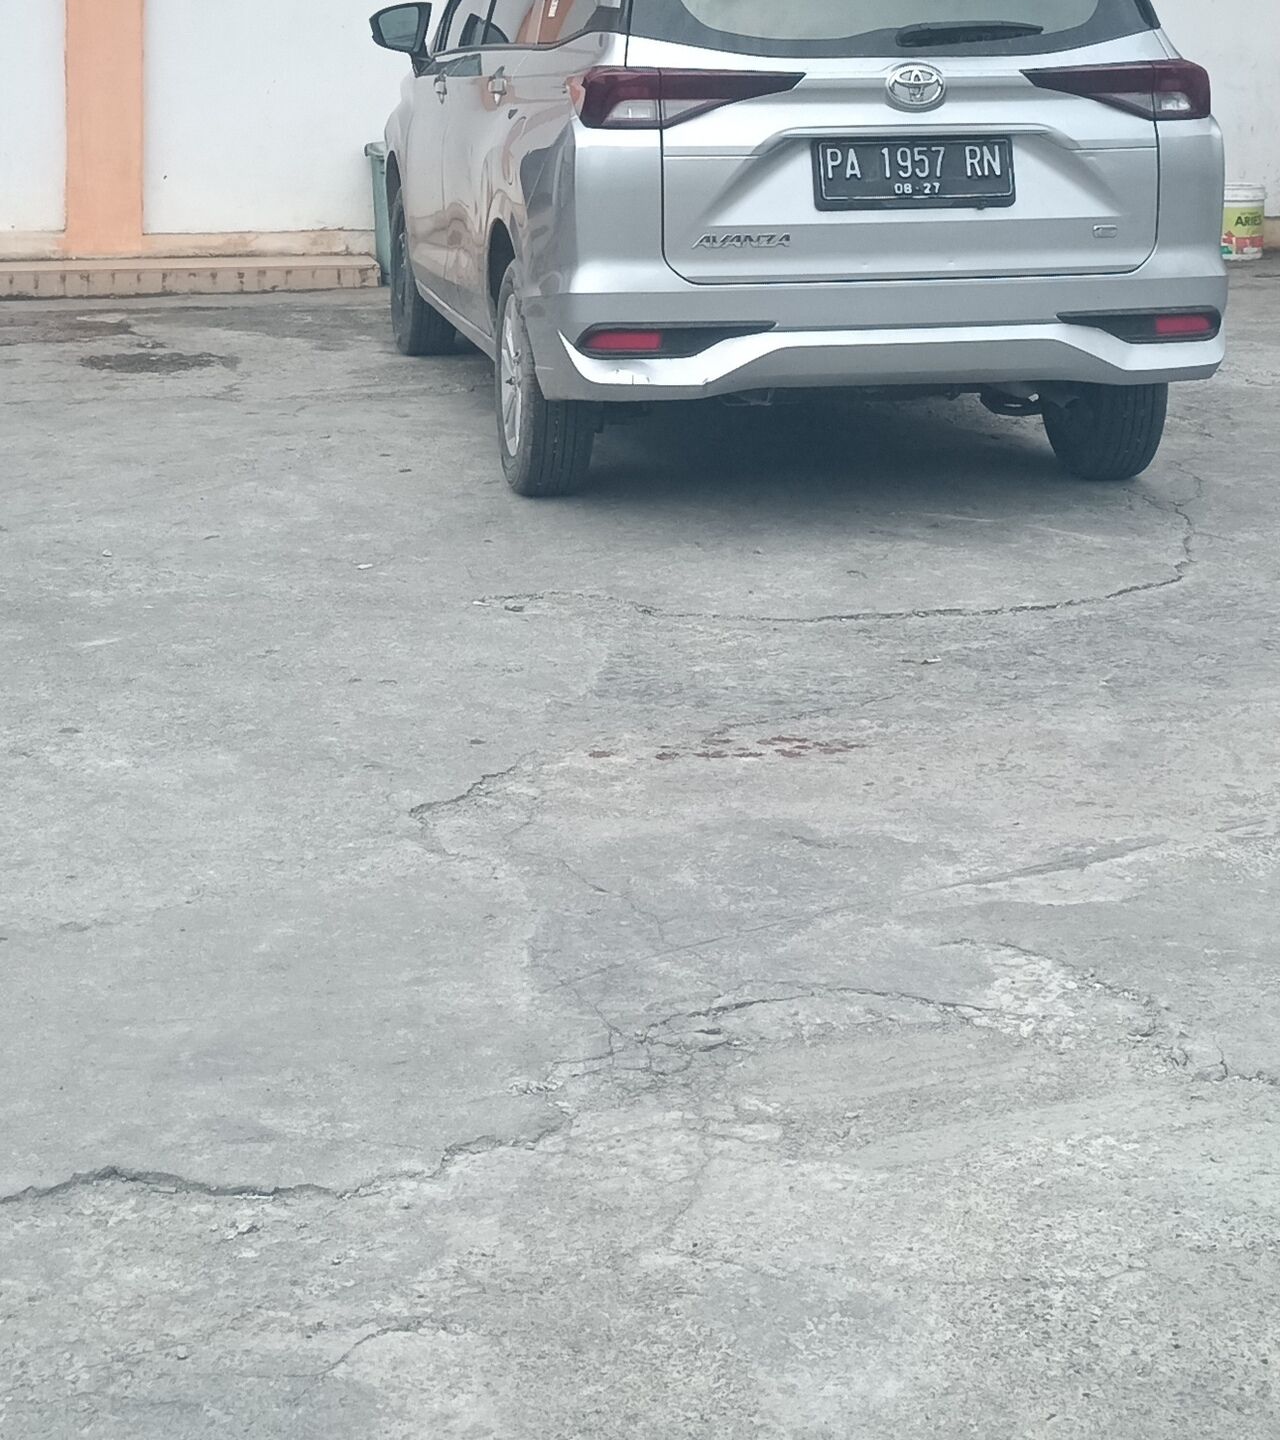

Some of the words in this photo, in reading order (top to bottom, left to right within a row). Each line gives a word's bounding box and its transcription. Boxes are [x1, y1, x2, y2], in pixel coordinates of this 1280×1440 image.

[826, 148, 862, 179] PA
[881, 146, 945, 178] 1957
[965, 145, 1001, 177] RN
[691, 232, 791, 249] AVANZA
